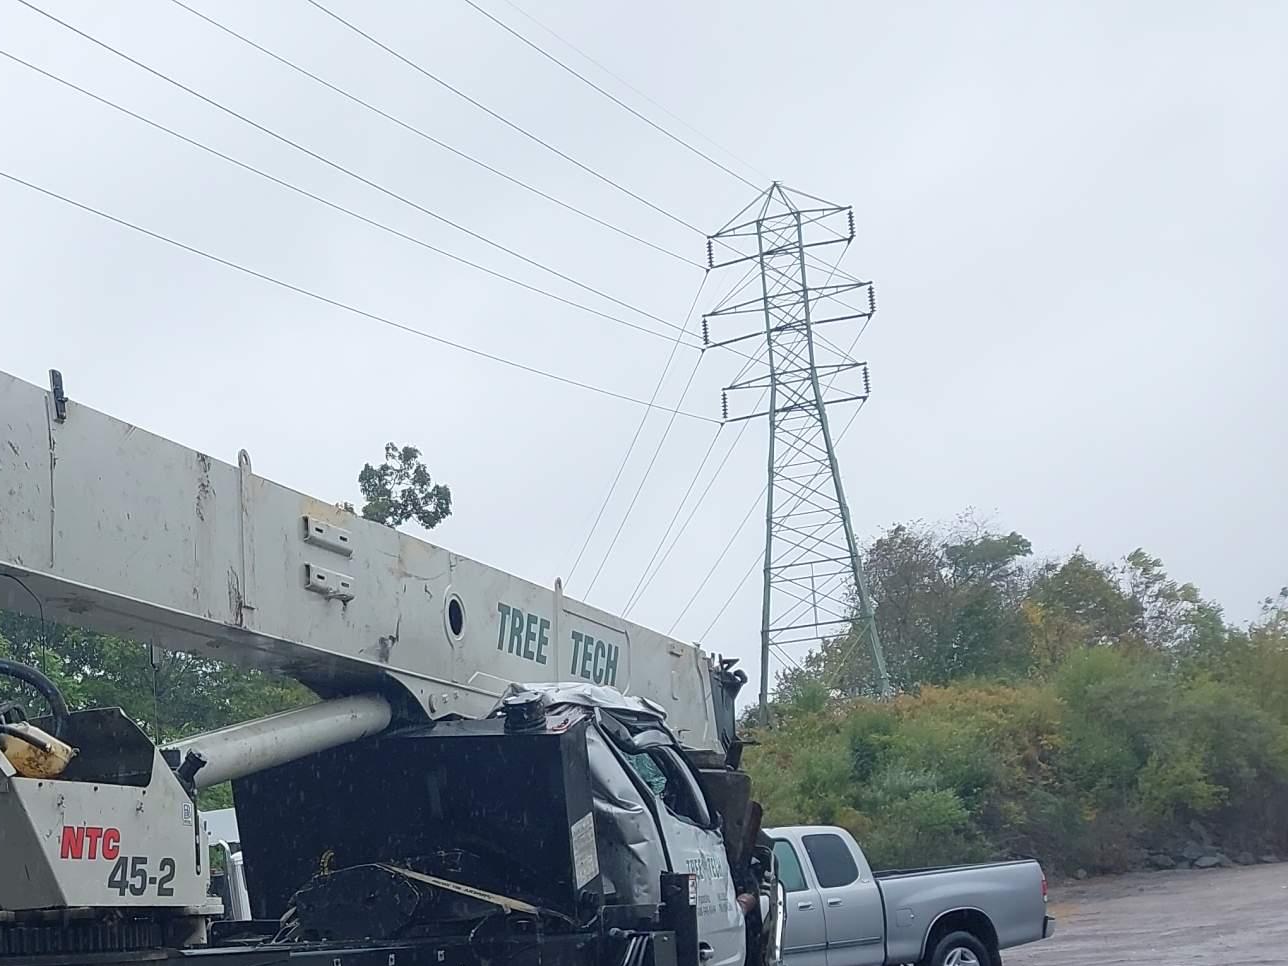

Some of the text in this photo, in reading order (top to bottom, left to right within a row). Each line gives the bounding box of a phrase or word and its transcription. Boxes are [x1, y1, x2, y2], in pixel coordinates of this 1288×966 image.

[496, 602, 620, 686] TREE TECH
[60, 825, 121, 861] NTC
[107, 856, 176, 897] 45-2
